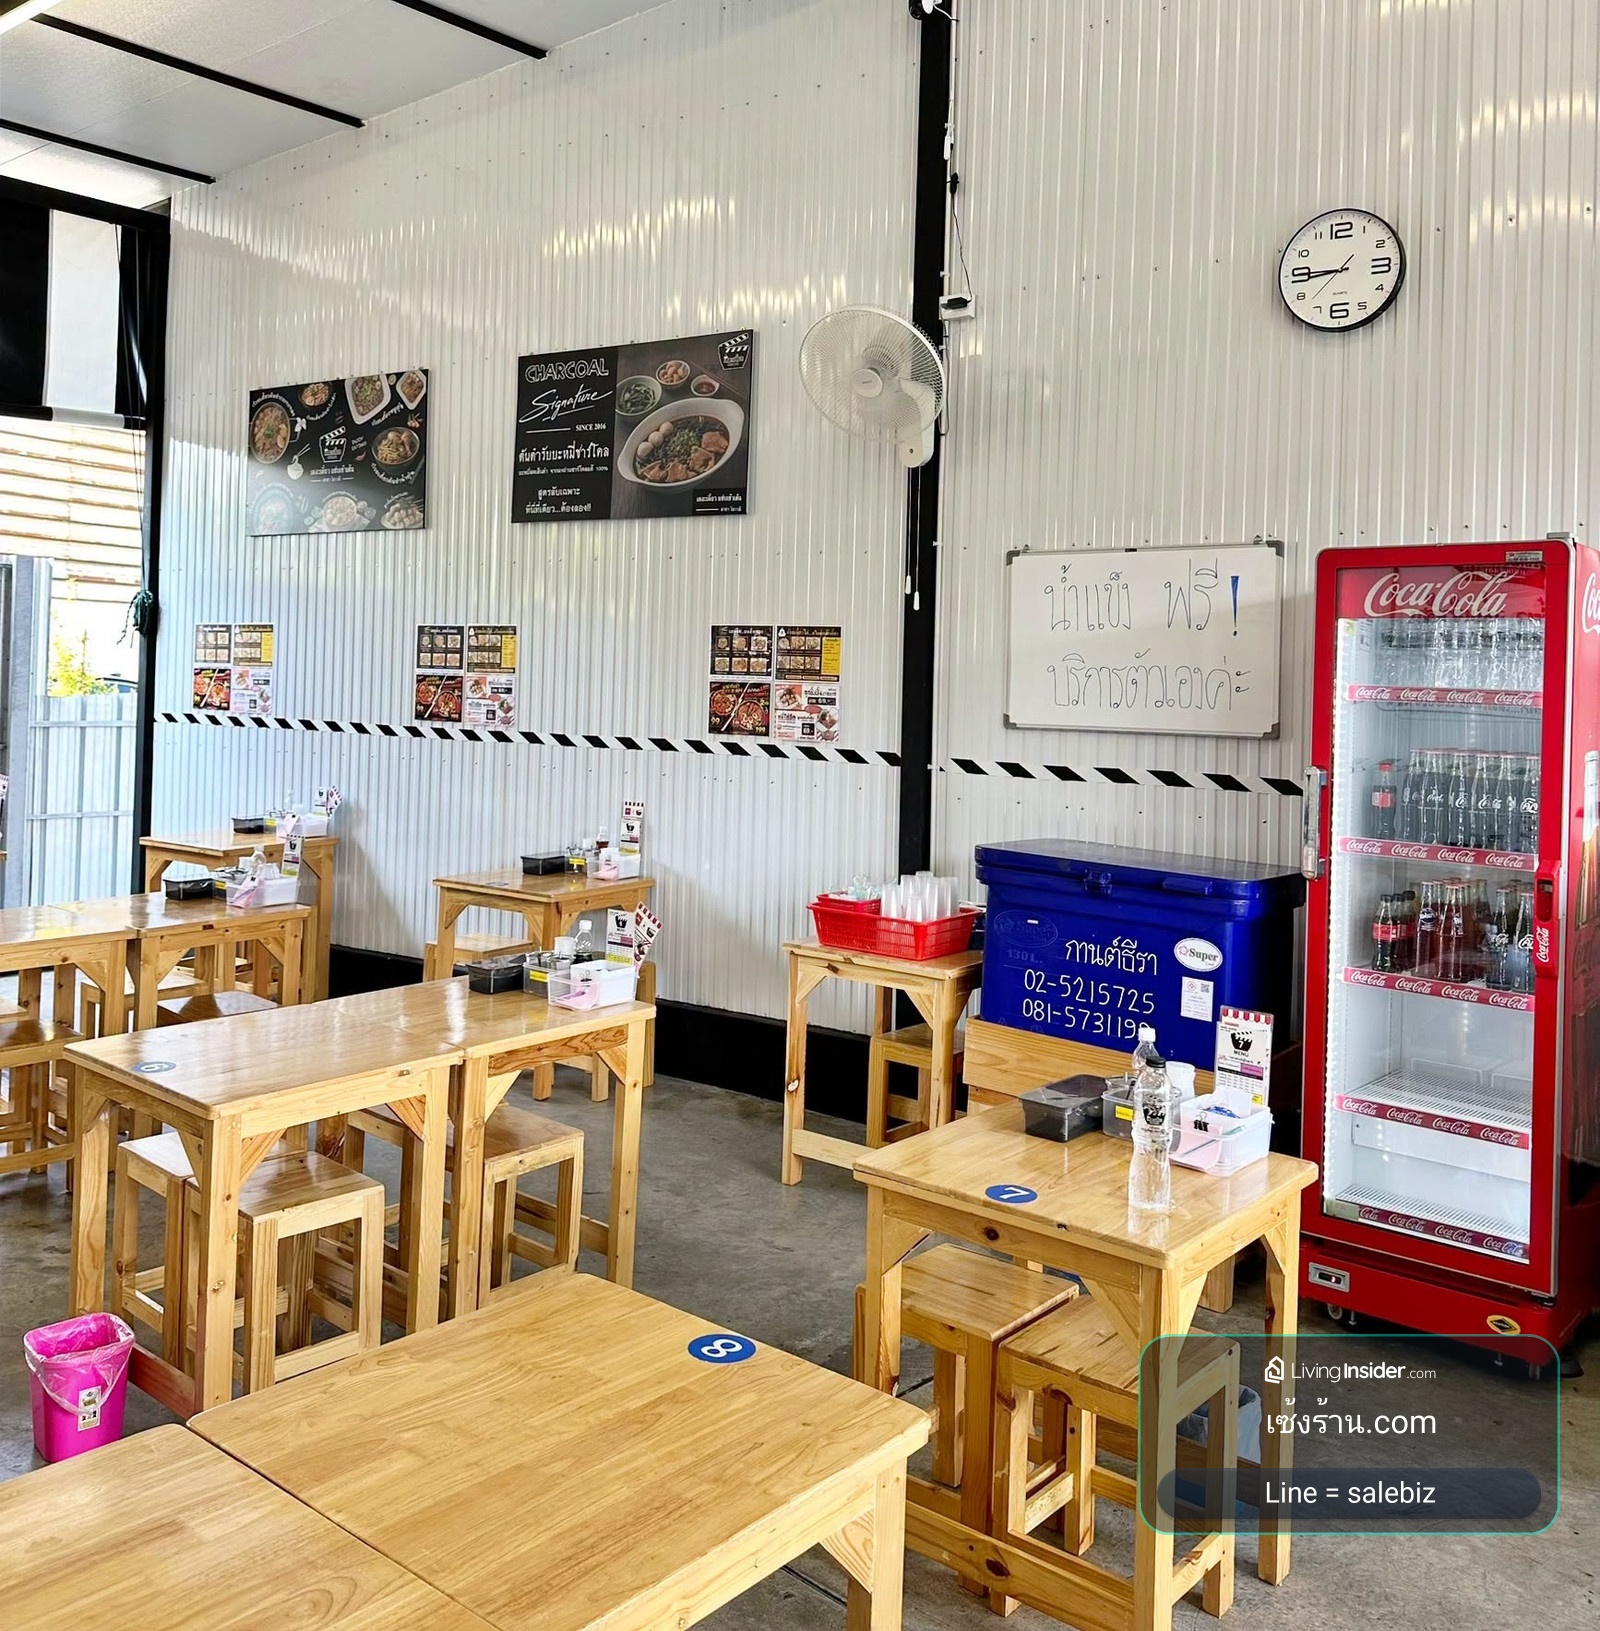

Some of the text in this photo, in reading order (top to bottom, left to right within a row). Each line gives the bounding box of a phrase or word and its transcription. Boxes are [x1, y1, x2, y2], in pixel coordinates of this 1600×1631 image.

[1315, 232, 1322, 240] 11
[1330, 222, 1353, 240] 12
[1375, 239, 1385, 248] 2
[1298, 249, 1309, 258] 10
[1371, 257, 1391, 275] 3
[1291, 266, 1311, 284] 9
[1296, 292, 1306, 300] 8
[1375, 284, 1384, 292] 4
[1312, 306, 1322, 314] 7
[1330, 302, 1349, 319] 6
[1357, 301, 1367, 310] 5
[525, 358, 609, 383] CHARCOAL
[519, 384, 613, 423] Signature
[575, 422, 606, 431] SINCE 2016
[1044, 563, 1131, 632] น้ำแข็ง
[1364, 570, 1517, 617] Coca-Cola
[1047, 648, 1251, 712] บริการตัวเองค่ะ
[1065, 936, 1158, 976] กานต์ธีรา
[1188, 948, 1218, 962] Super
[1024, 969, 1155, 1014] 02-5215725
[1238, 1041, 1244, 1049] 7
[999, 1186, 1030, 1199] 7
[701, 1338, 743, 1358] 8
